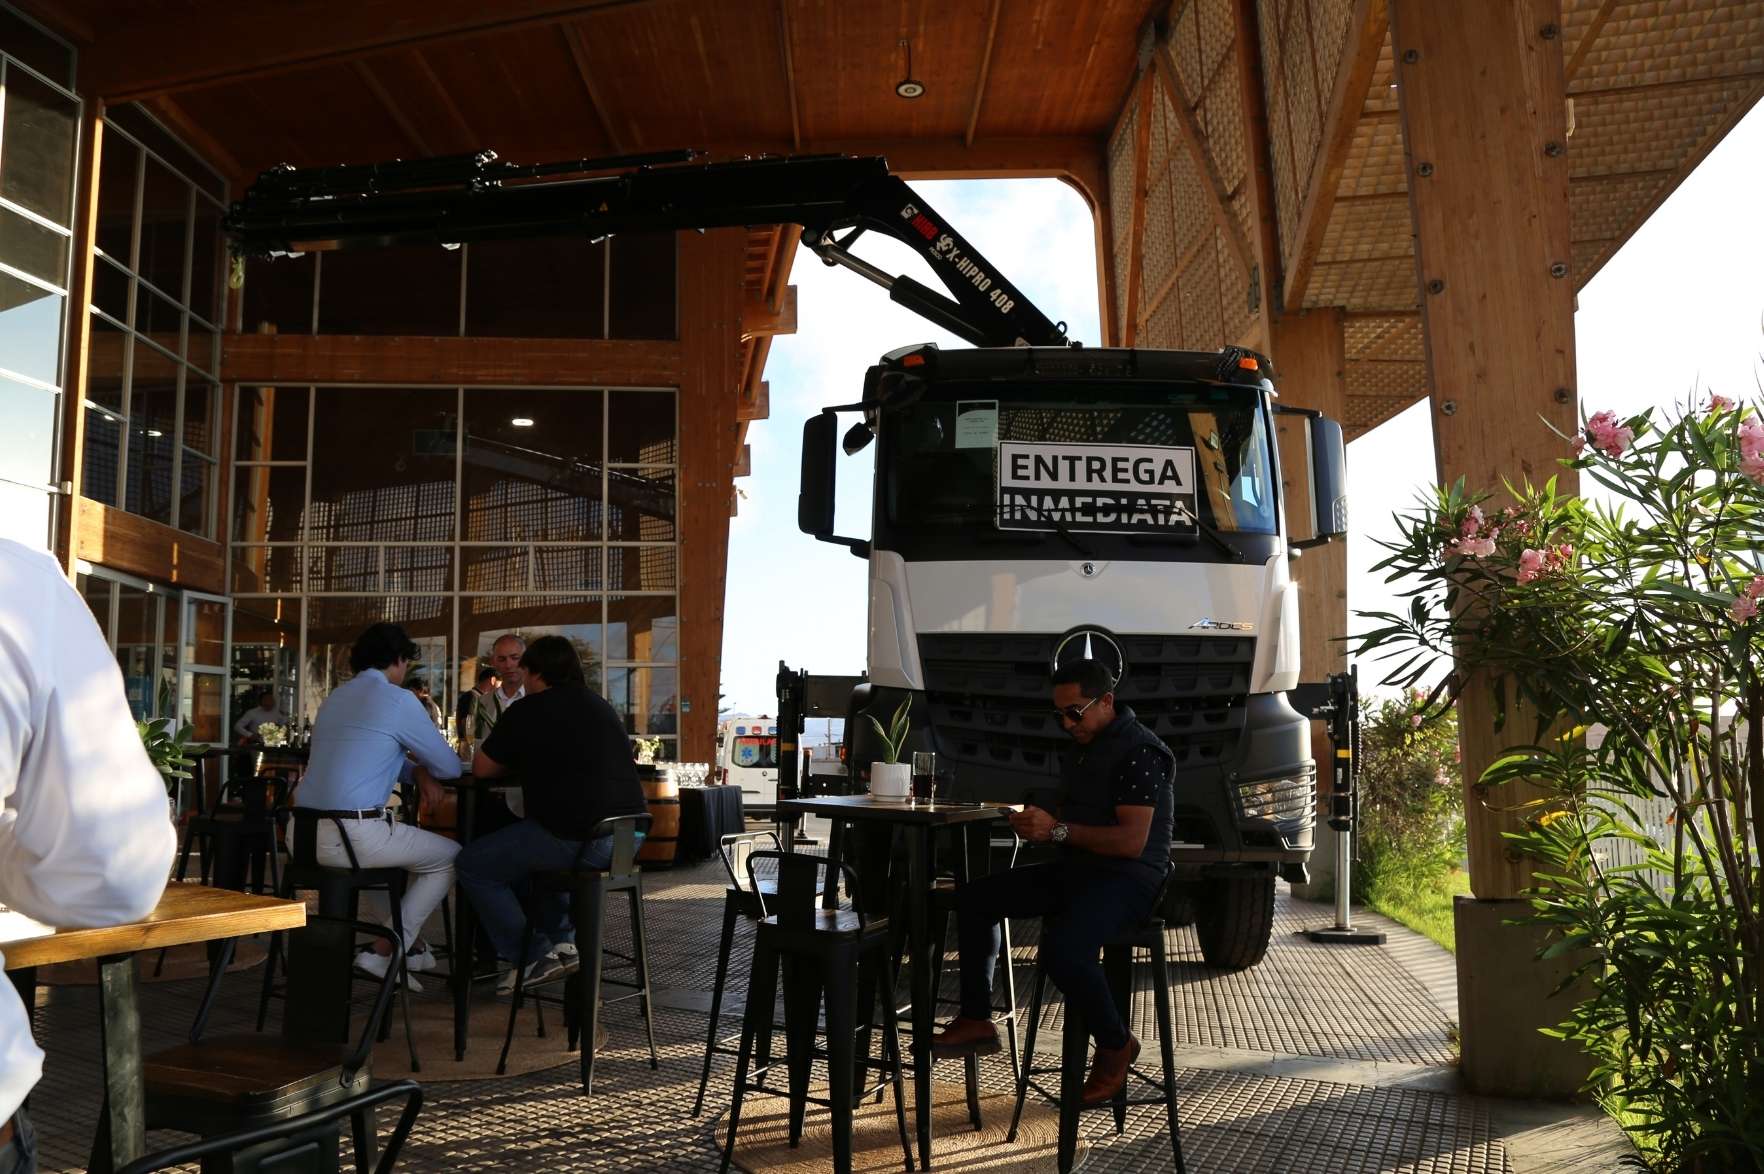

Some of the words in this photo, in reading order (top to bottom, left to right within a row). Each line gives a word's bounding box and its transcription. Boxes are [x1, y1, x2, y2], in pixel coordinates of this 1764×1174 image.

[946, 247, 992, 292] X-HIPRO
[989, 288, 1015, 314] 408
[1011, 453, 1183, 486] ENTREGA
[1003, 494, 1193, 526] INMEDIATA
